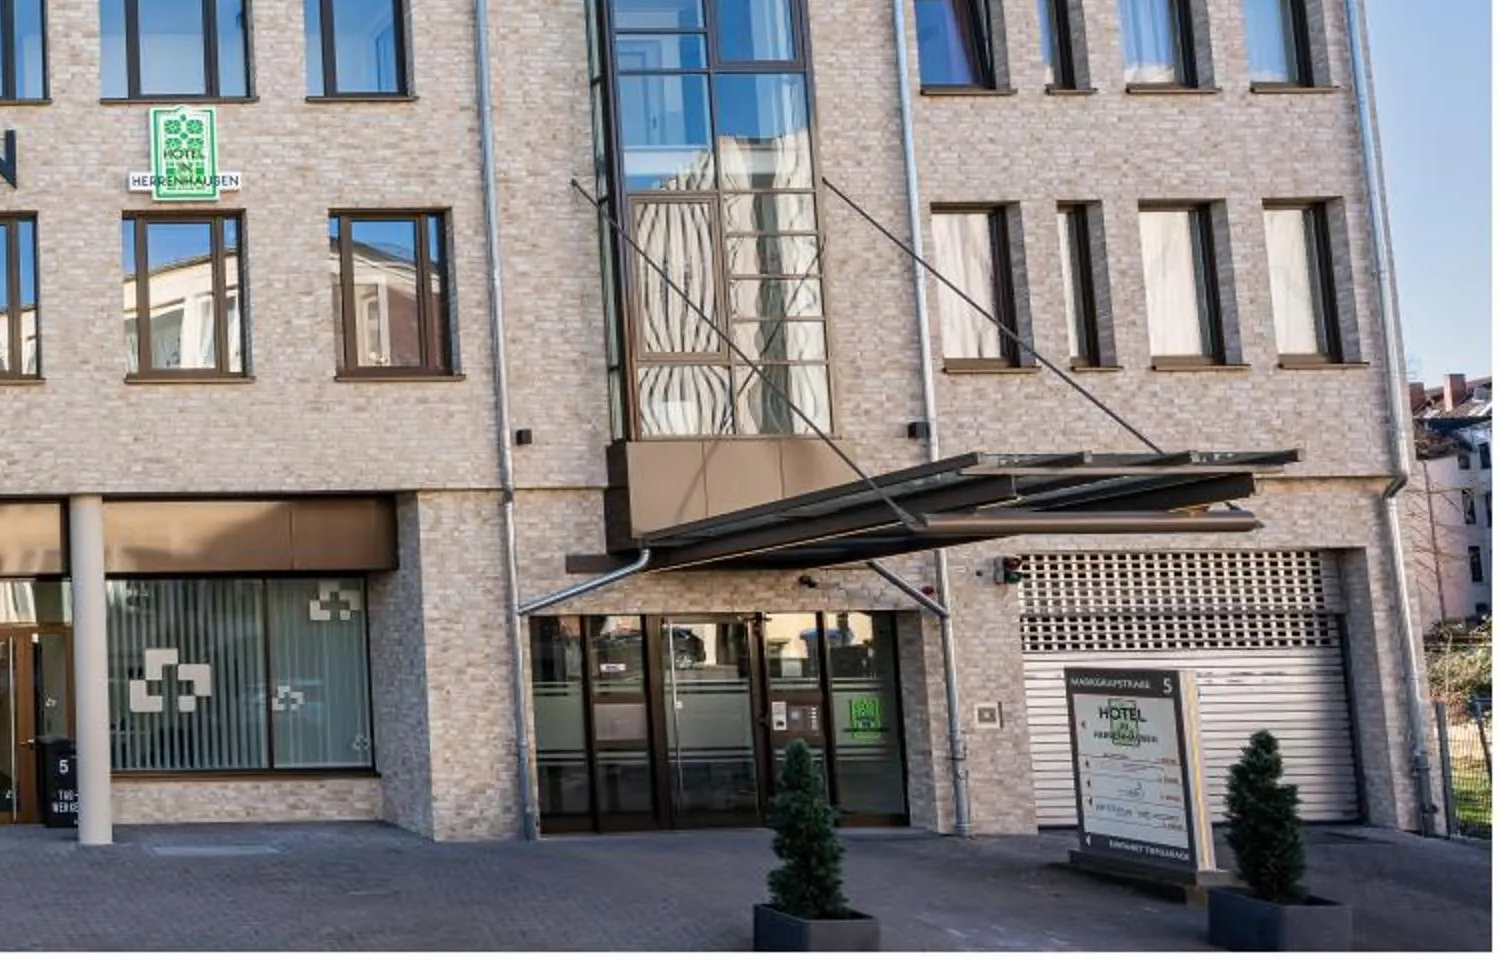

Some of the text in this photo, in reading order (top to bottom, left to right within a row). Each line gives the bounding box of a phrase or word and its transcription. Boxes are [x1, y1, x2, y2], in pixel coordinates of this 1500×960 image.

[163, 149, 206, 160] HOTEL
[131, 175, 239, 187] HERRENHAUSEN
[1162, 677, 1174, 694] 5
[1099, 706, 1148, 723] HOTEL
[60, 759, 69, 774] 5
